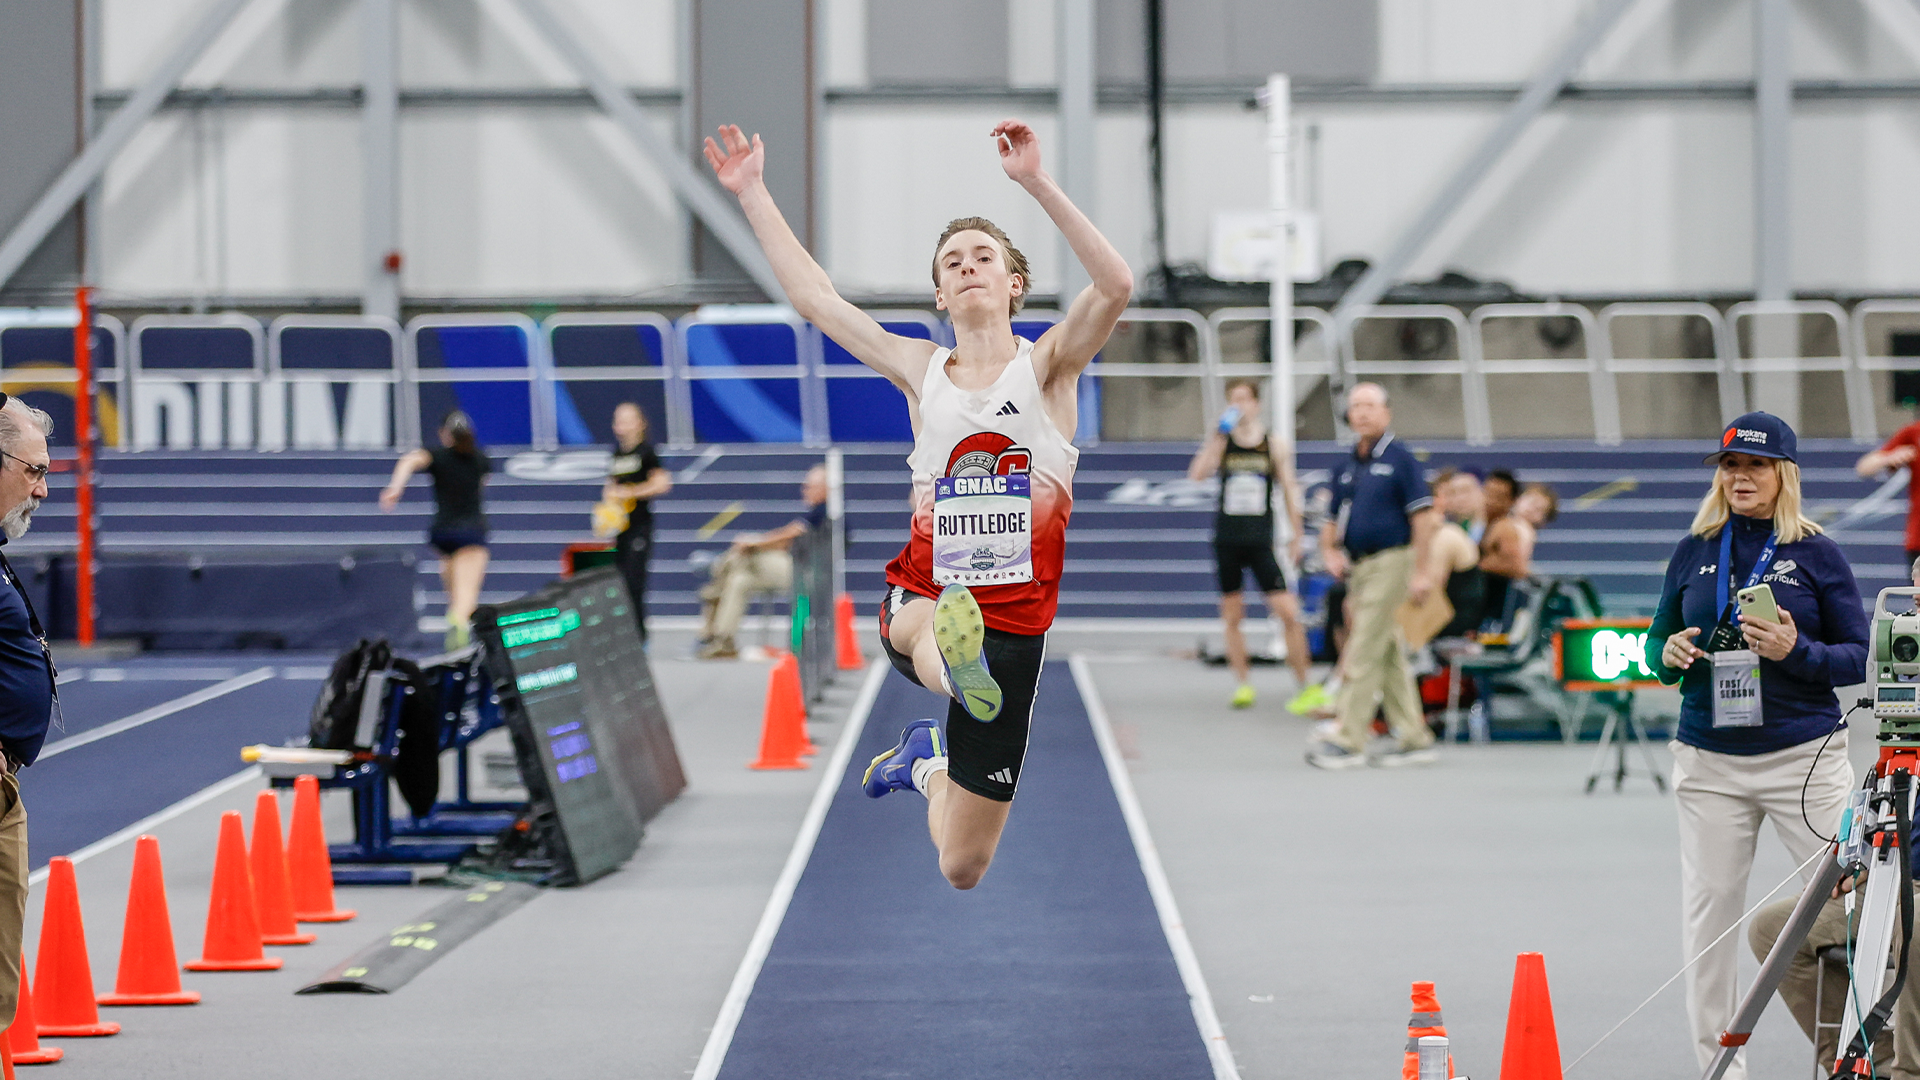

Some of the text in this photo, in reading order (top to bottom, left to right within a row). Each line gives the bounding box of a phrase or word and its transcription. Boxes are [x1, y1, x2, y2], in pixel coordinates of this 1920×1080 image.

[954, 477, 1007, 495] GNAC
[938, 512, 1026, 536] RUTTLEDGE
[1762, 574, 1800, 587] OFFICIAL
[1720, 688, 1755, 699] SEASON
